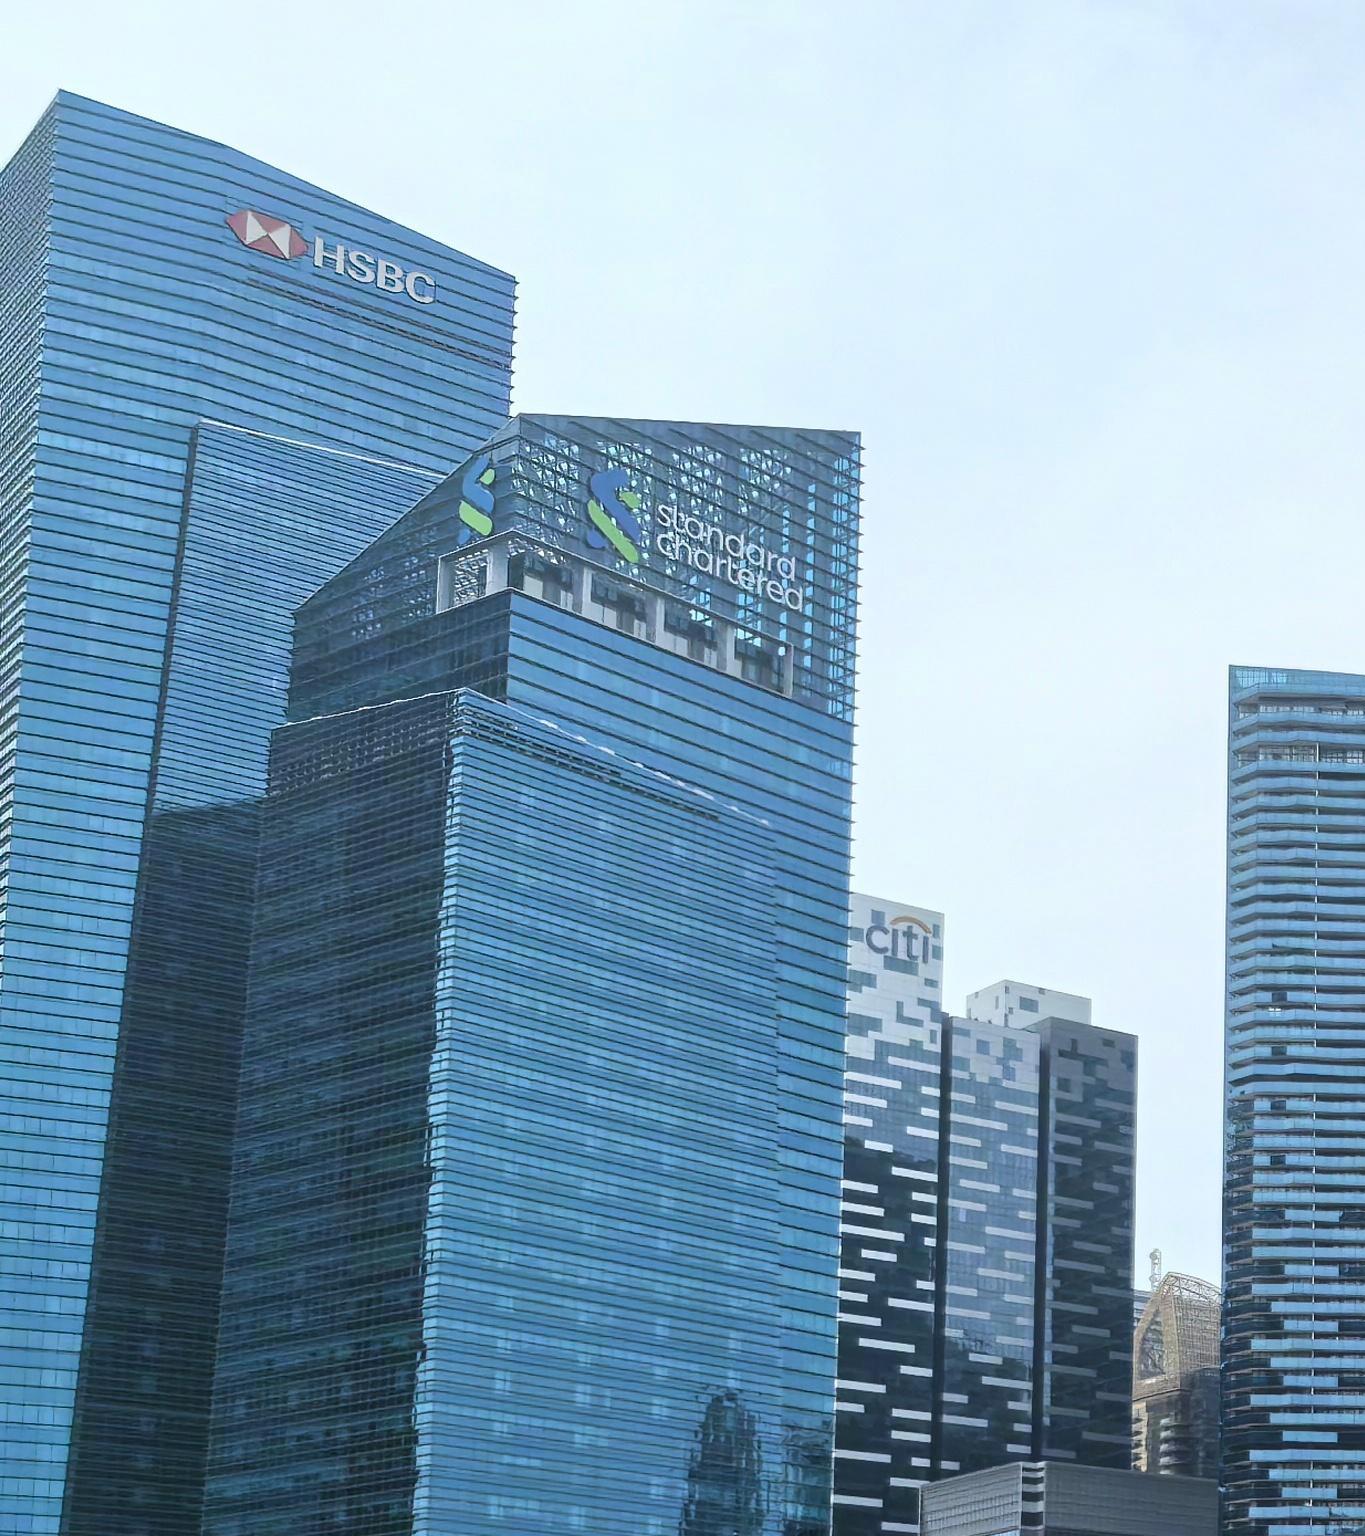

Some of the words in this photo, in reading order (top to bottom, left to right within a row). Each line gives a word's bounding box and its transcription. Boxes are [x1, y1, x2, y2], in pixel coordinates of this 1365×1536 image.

[313, 235, 437, 305] HSBC
[656, 504, 796, 582] standard
[656, 533, 805, 612] chartered
[866, 921, 930, 965] citi
